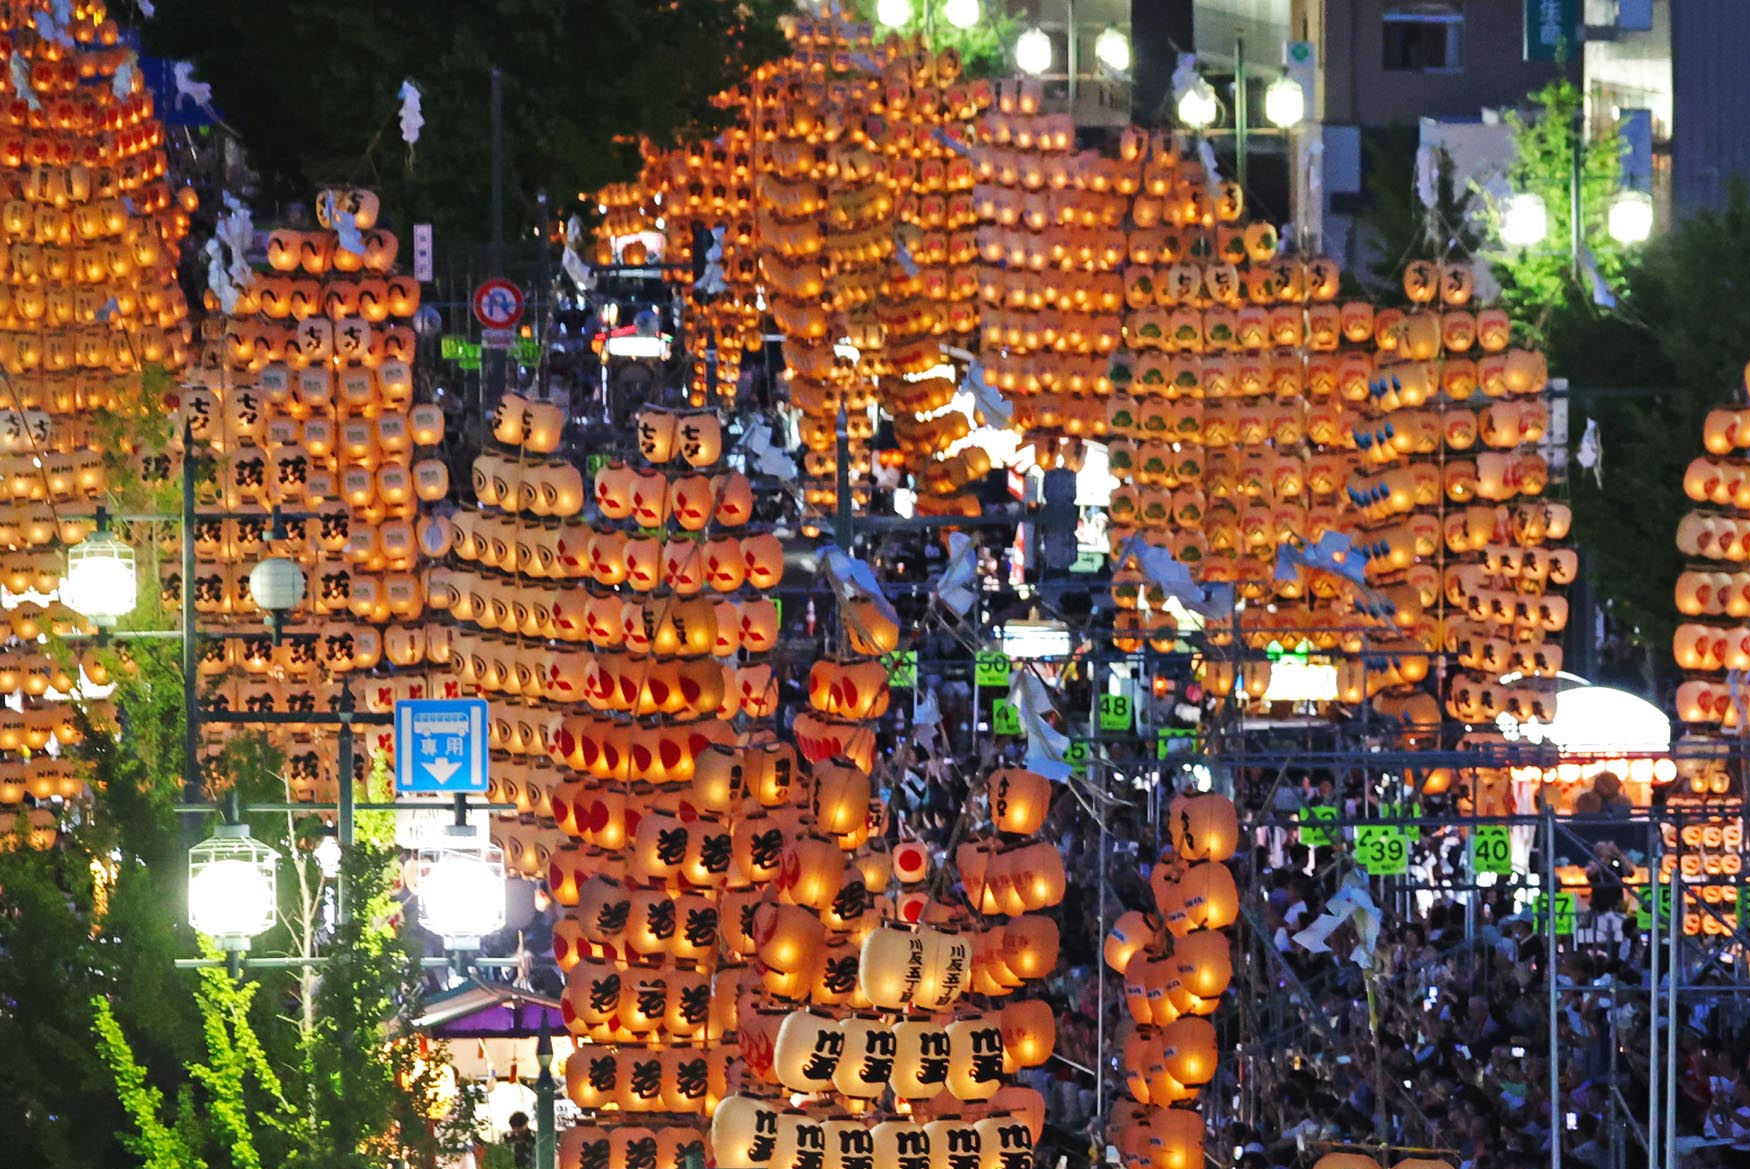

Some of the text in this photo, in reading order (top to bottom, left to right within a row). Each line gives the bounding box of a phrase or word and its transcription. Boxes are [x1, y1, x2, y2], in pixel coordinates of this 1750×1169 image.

[1101, 696, 1128, 717] 48
[420, 736, 464, 756] 専用
[1370, 840, 1402, 861] 39
[1476, 840, 1508, 861] 40
[900, 939, 923, 1003] 川反五丁目
